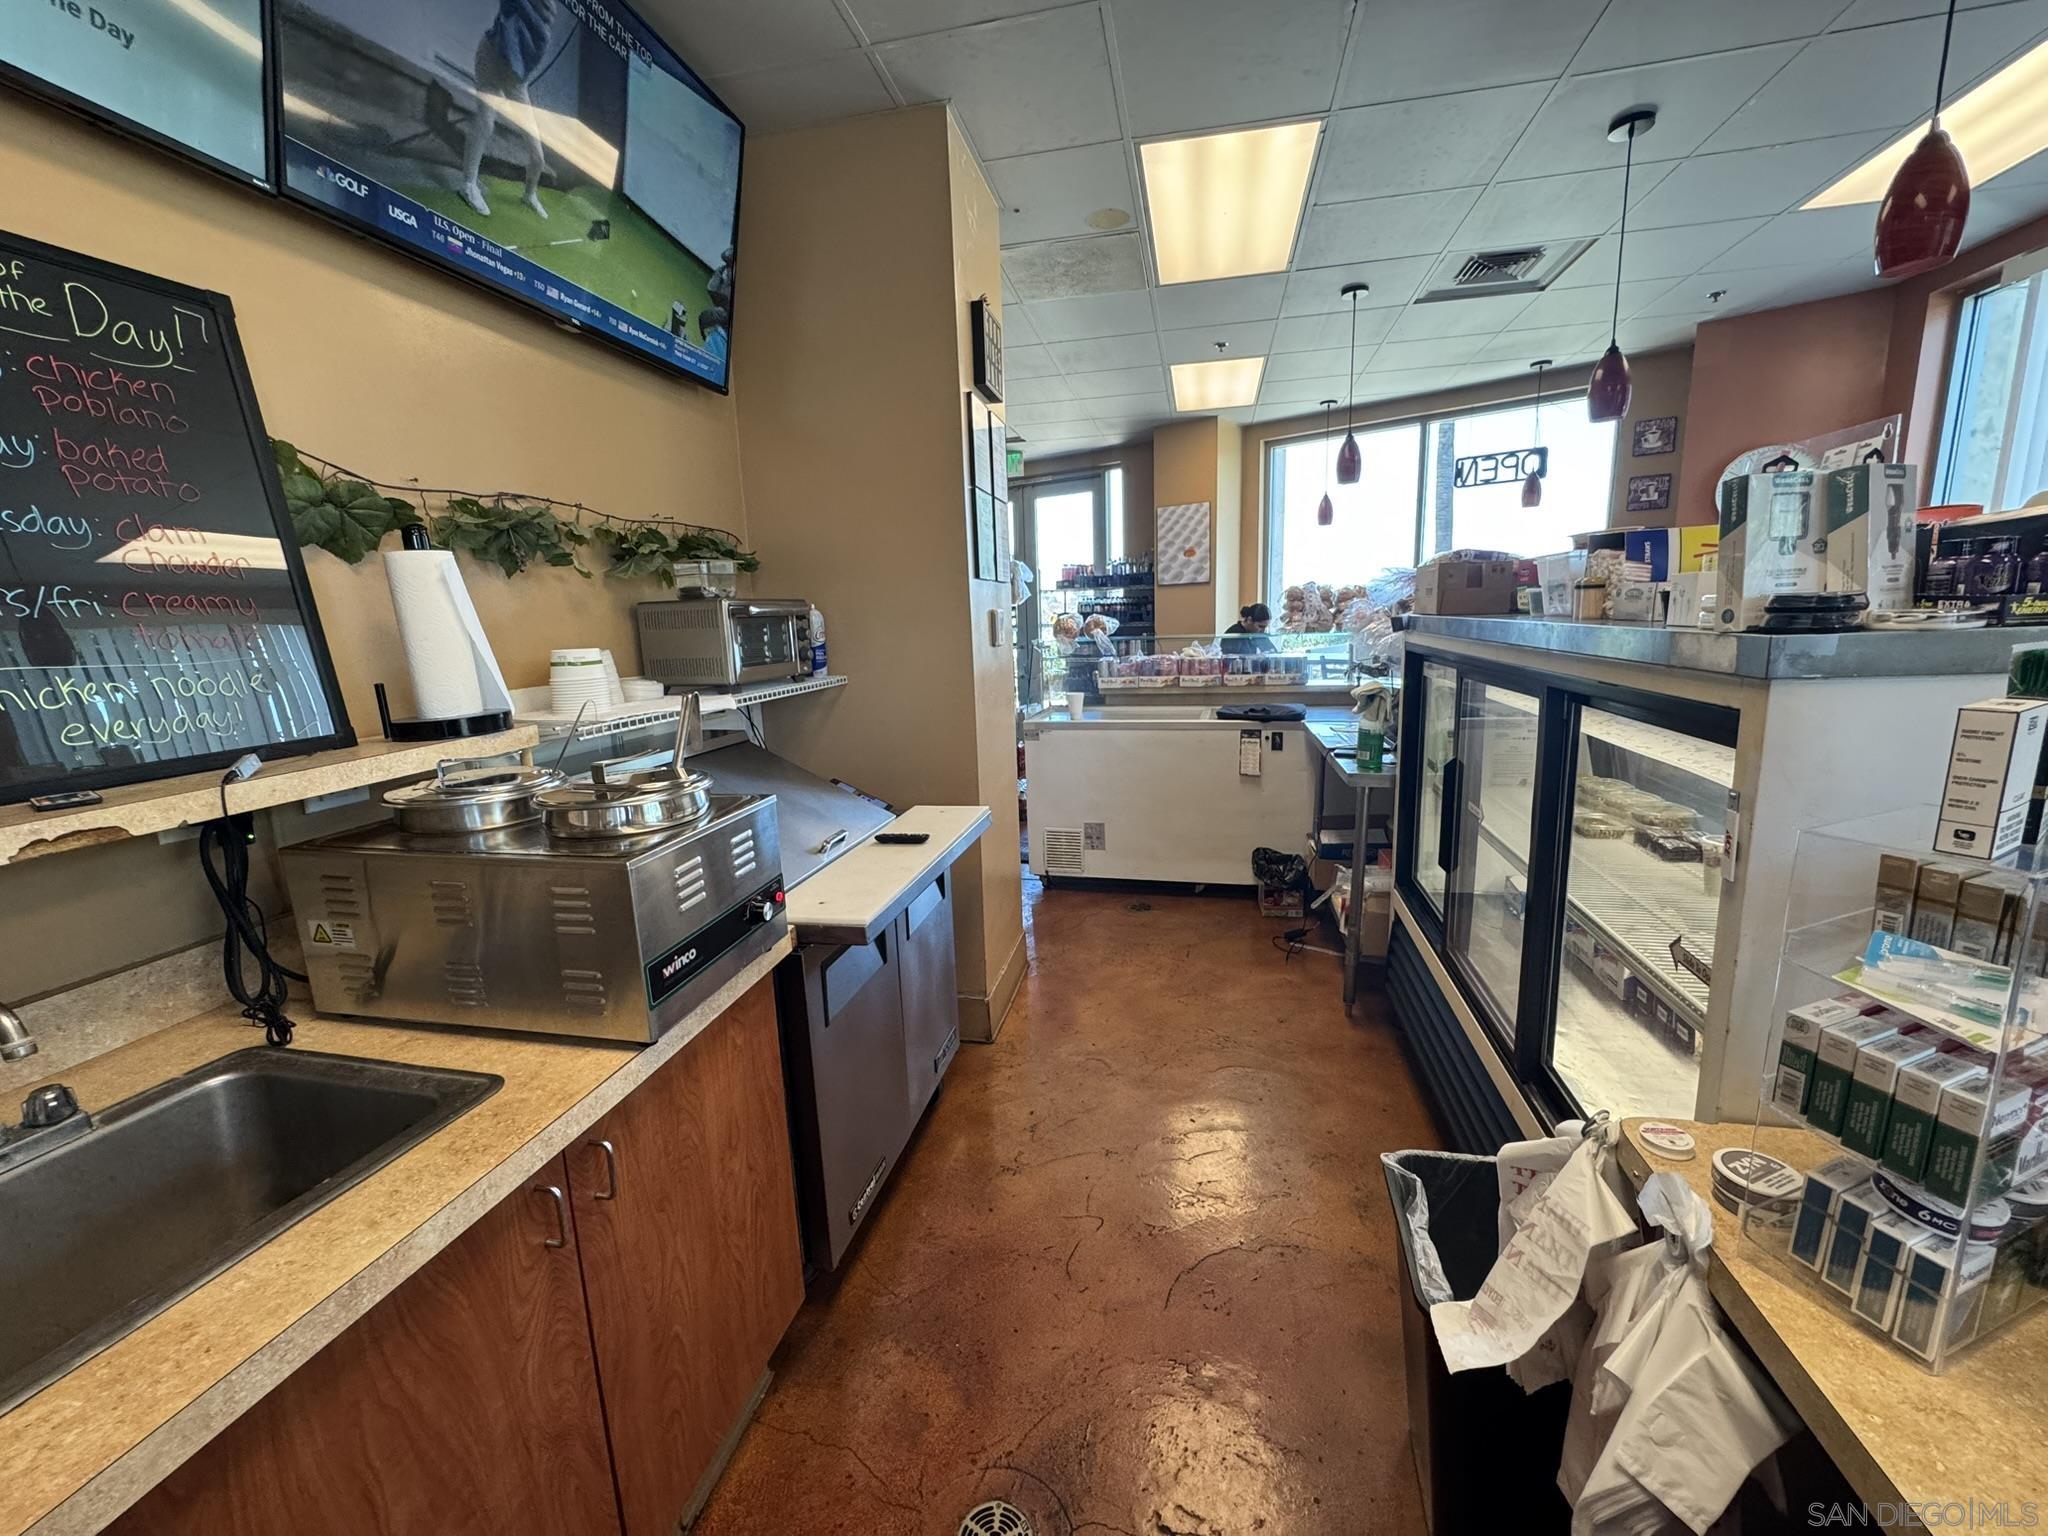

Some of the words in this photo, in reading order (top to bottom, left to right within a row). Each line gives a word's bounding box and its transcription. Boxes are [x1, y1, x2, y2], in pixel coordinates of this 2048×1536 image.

[88, 7, 134, 50] Day
[587, 12, 607, 42] THE
[608, 35, 628, 60] CAR
[616, 21, 634, 49] THE
[634, 40, 653, 65] TOP
[334, 172, 369, 198] GOLF
[388, 204, 418, 229] USGA
[433, 215, 451, 232] U.S.
[452, 227, 475, 244] Open
[481, 239, 503, 258] Final
[496, 261, 514, 277] Vegas
[0, 284, 53, 318] the
[64, 282, 184, 368] Day!
[53, 427, 169, 473] baked
[0, 504, 103, 550] sday:
[0, 675, 137, 712] hicken
[151, 668, 272, 700] noodle
[60, 701, 243, 746] everyday!
[662, 947, 697, 978] winco
[1728, 1156, 1767, 1175] ZYN
